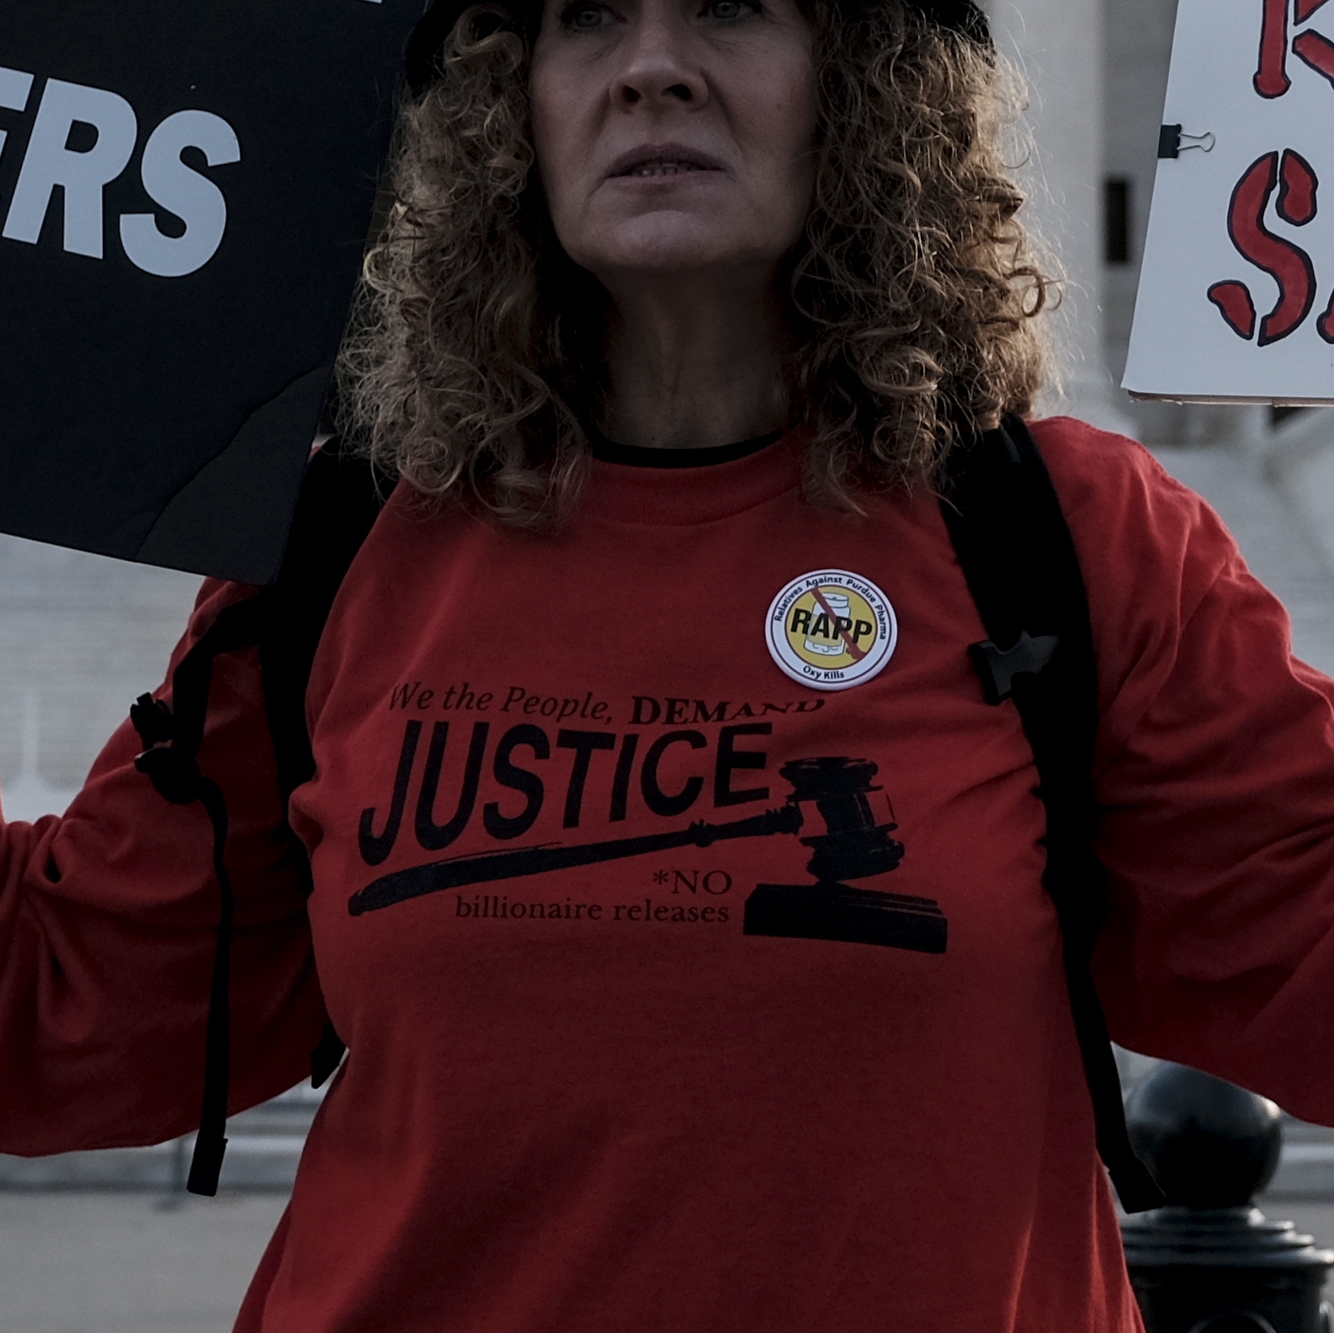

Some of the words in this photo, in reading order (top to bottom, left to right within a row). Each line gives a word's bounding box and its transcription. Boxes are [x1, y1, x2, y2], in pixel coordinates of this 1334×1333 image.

[774, 586, 803, 622] Relatives
[805, 576, 843, 588] Against
[846, 578, 876, 603] Purdue
[874, 604, 886, 640] Pharma
[790, 608, 873, 644] RAPP
[802, 665, 821, 680] Oxy
[823, 671, 845, 680] Kills
[388, 681, 432, 710] We
[443, 683, 491, 711] the
[501, 686, 613, 725] People,
[627, 696, 828, 726] DEMAND
[358, 719, 773, 866] JUSTICE
[456, 895, 603, 921] billionaire
[613, 899, 730, 923] releases
